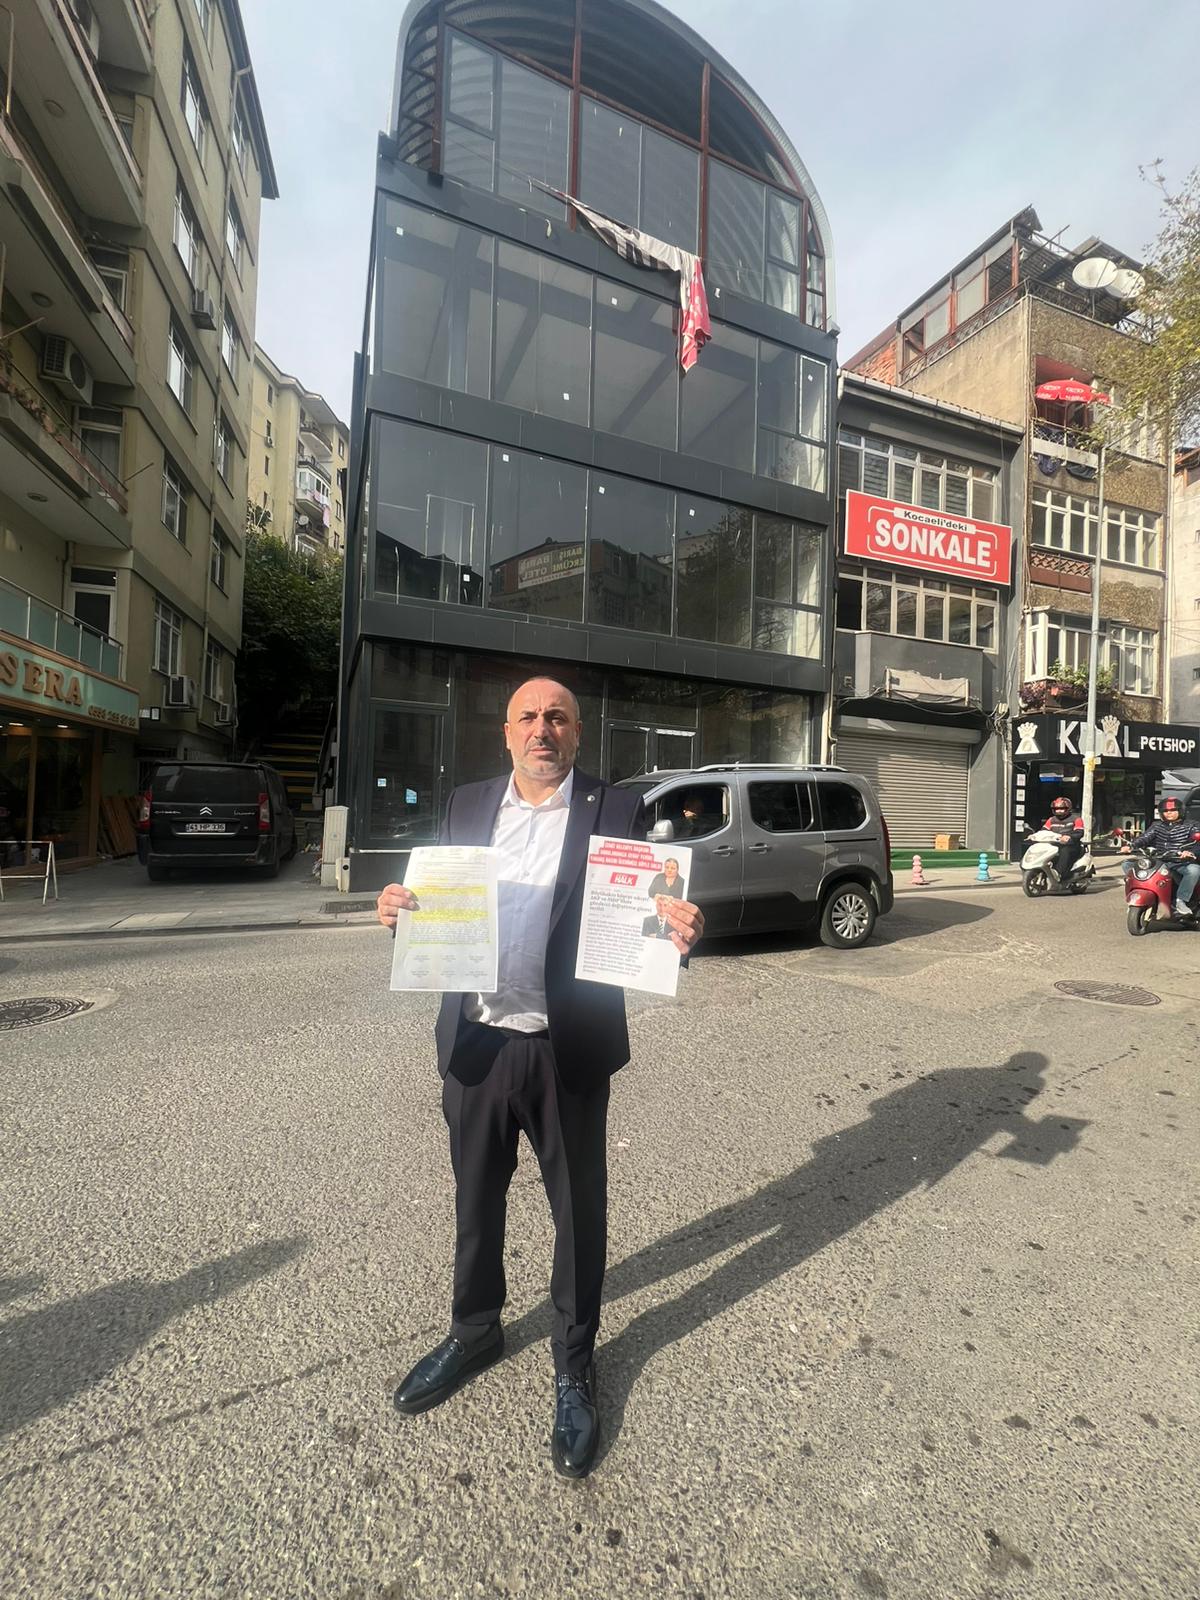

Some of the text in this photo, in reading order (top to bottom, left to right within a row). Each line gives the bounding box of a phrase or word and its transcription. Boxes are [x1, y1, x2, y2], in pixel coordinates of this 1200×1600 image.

[904, 510, 968, 532] Kocaeli'deki
[875, 518, 992, 568] SONKALE
[1140, 735, 1196, 753] PETSHOP
[614, 873, 633, 886] HALK
